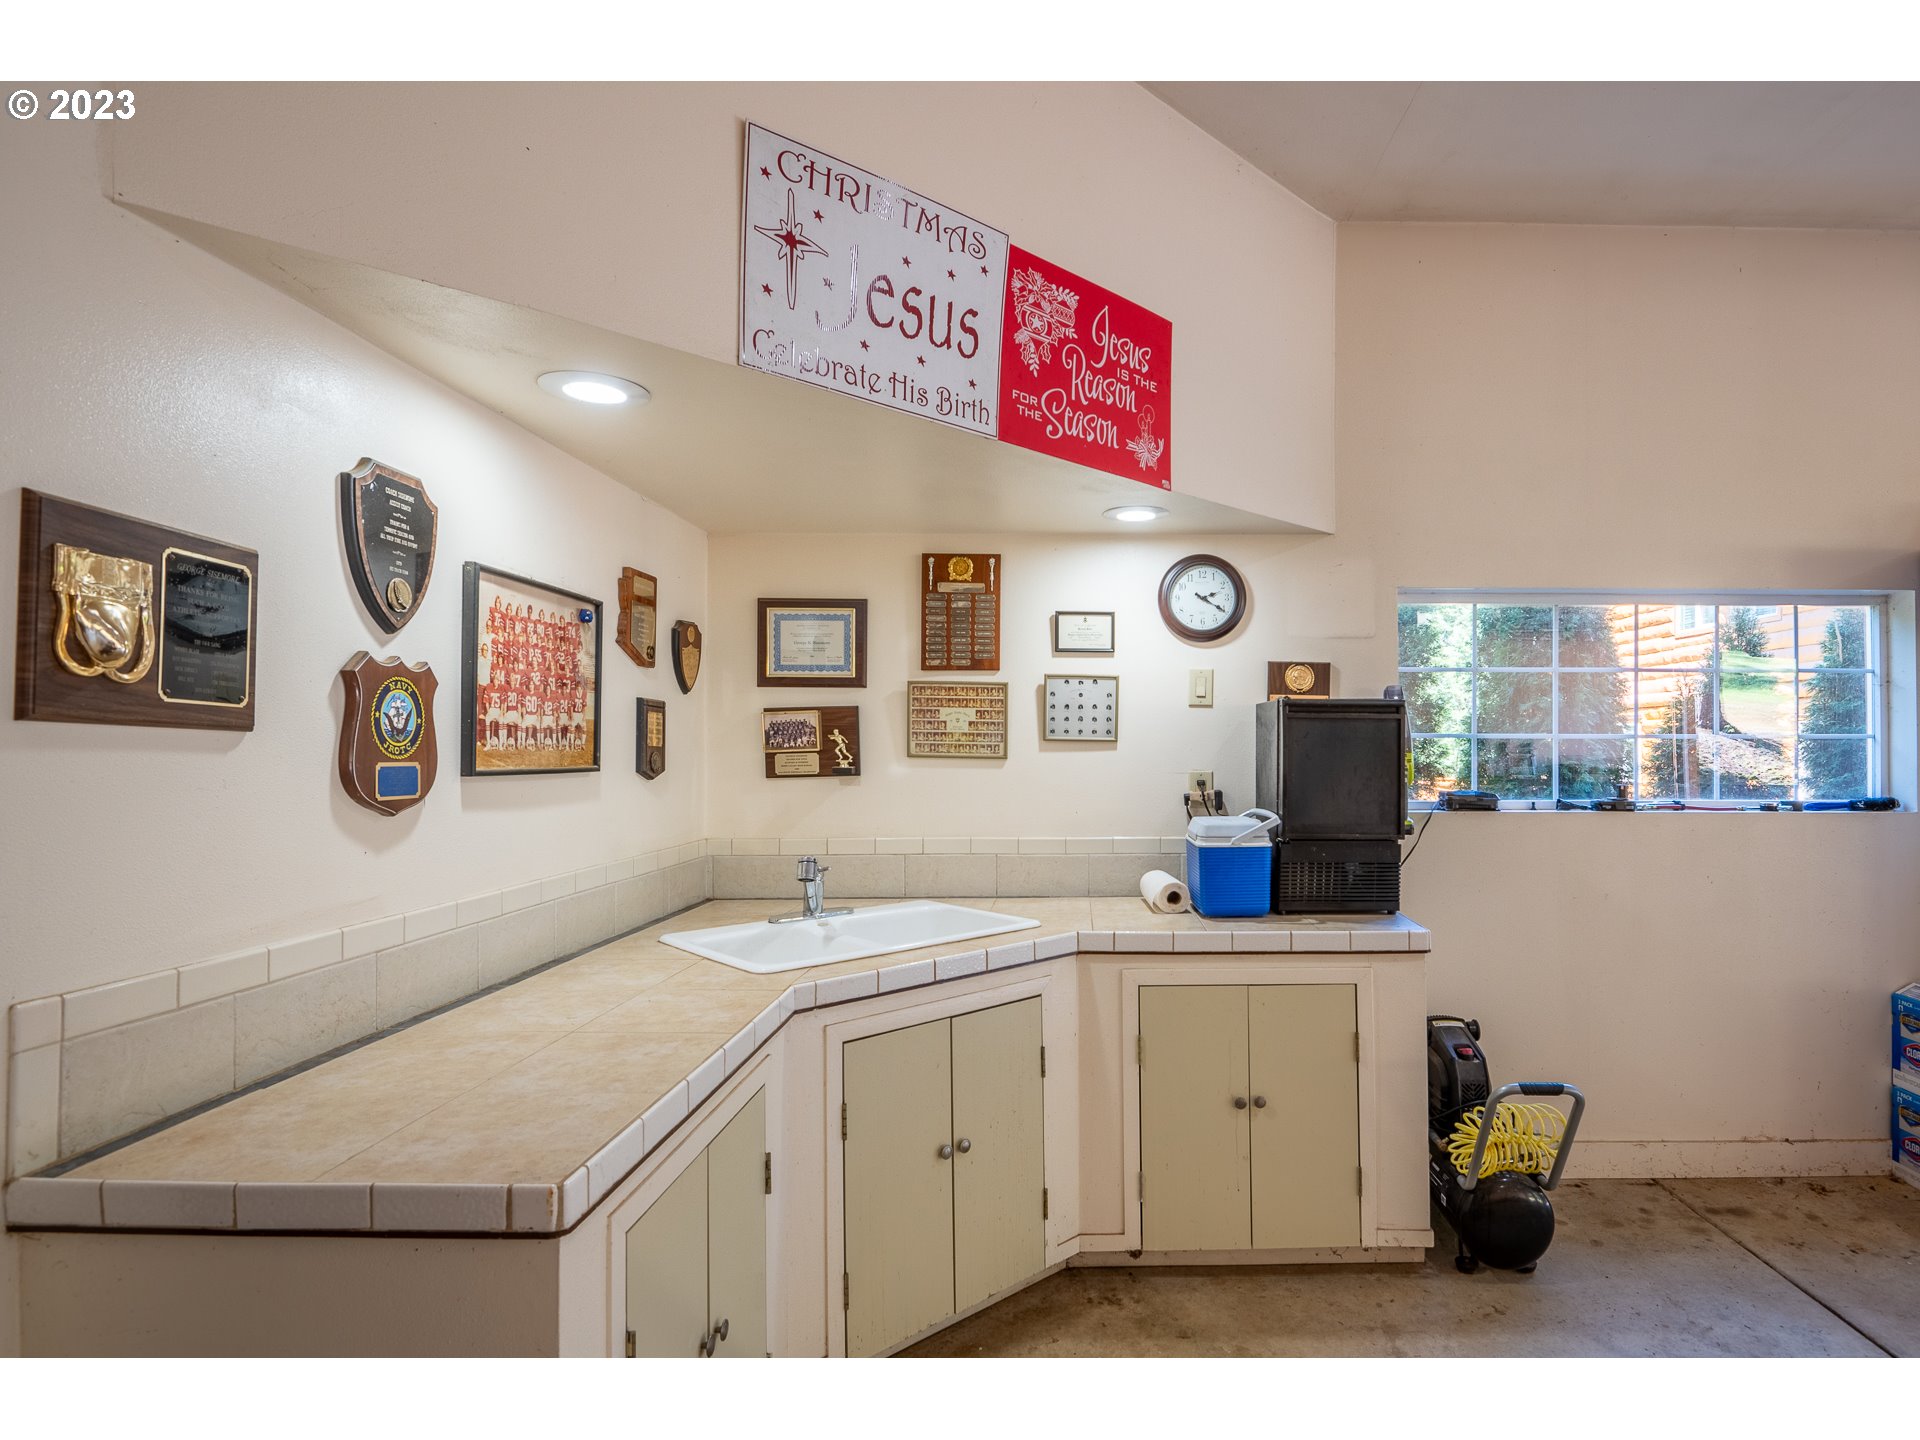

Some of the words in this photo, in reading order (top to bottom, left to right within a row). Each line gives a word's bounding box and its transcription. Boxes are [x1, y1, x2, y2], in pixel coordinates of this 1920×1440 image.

[777, 150, 987, 260] CHRISTMAS
[815, 244, 979, 359] Jesus
[1091, 305, 1151, 373] Jesus
[753, 329, 882, 394] Celebrate
[889, 372, 928, 407] His
[936, 386, 990, 426] Birth
[1062, 343, 1137, 413] Reason
[1117, 367, 1129, 382] IS
[1133, 373, 1158, 393] THE
[1012, 389, 1038, 407] FOR
[1016, 404, 1043, 422] THE
[1041, 388, 1119, 449] Season
[177, 562, 206, 576] GEORGE
[207, 569, 241, 583] SISEMORE
[1187, 573, 1194, 582] 11
[1198, 570, 1207, 579] 12
[389, 681, 413, 695] NAVY
[490, 692, 501, 708] 75
[508, 691, 518, 707] 20
[525, 695, 538, 713] 60
[383, 741, 412, 755] JROTC
